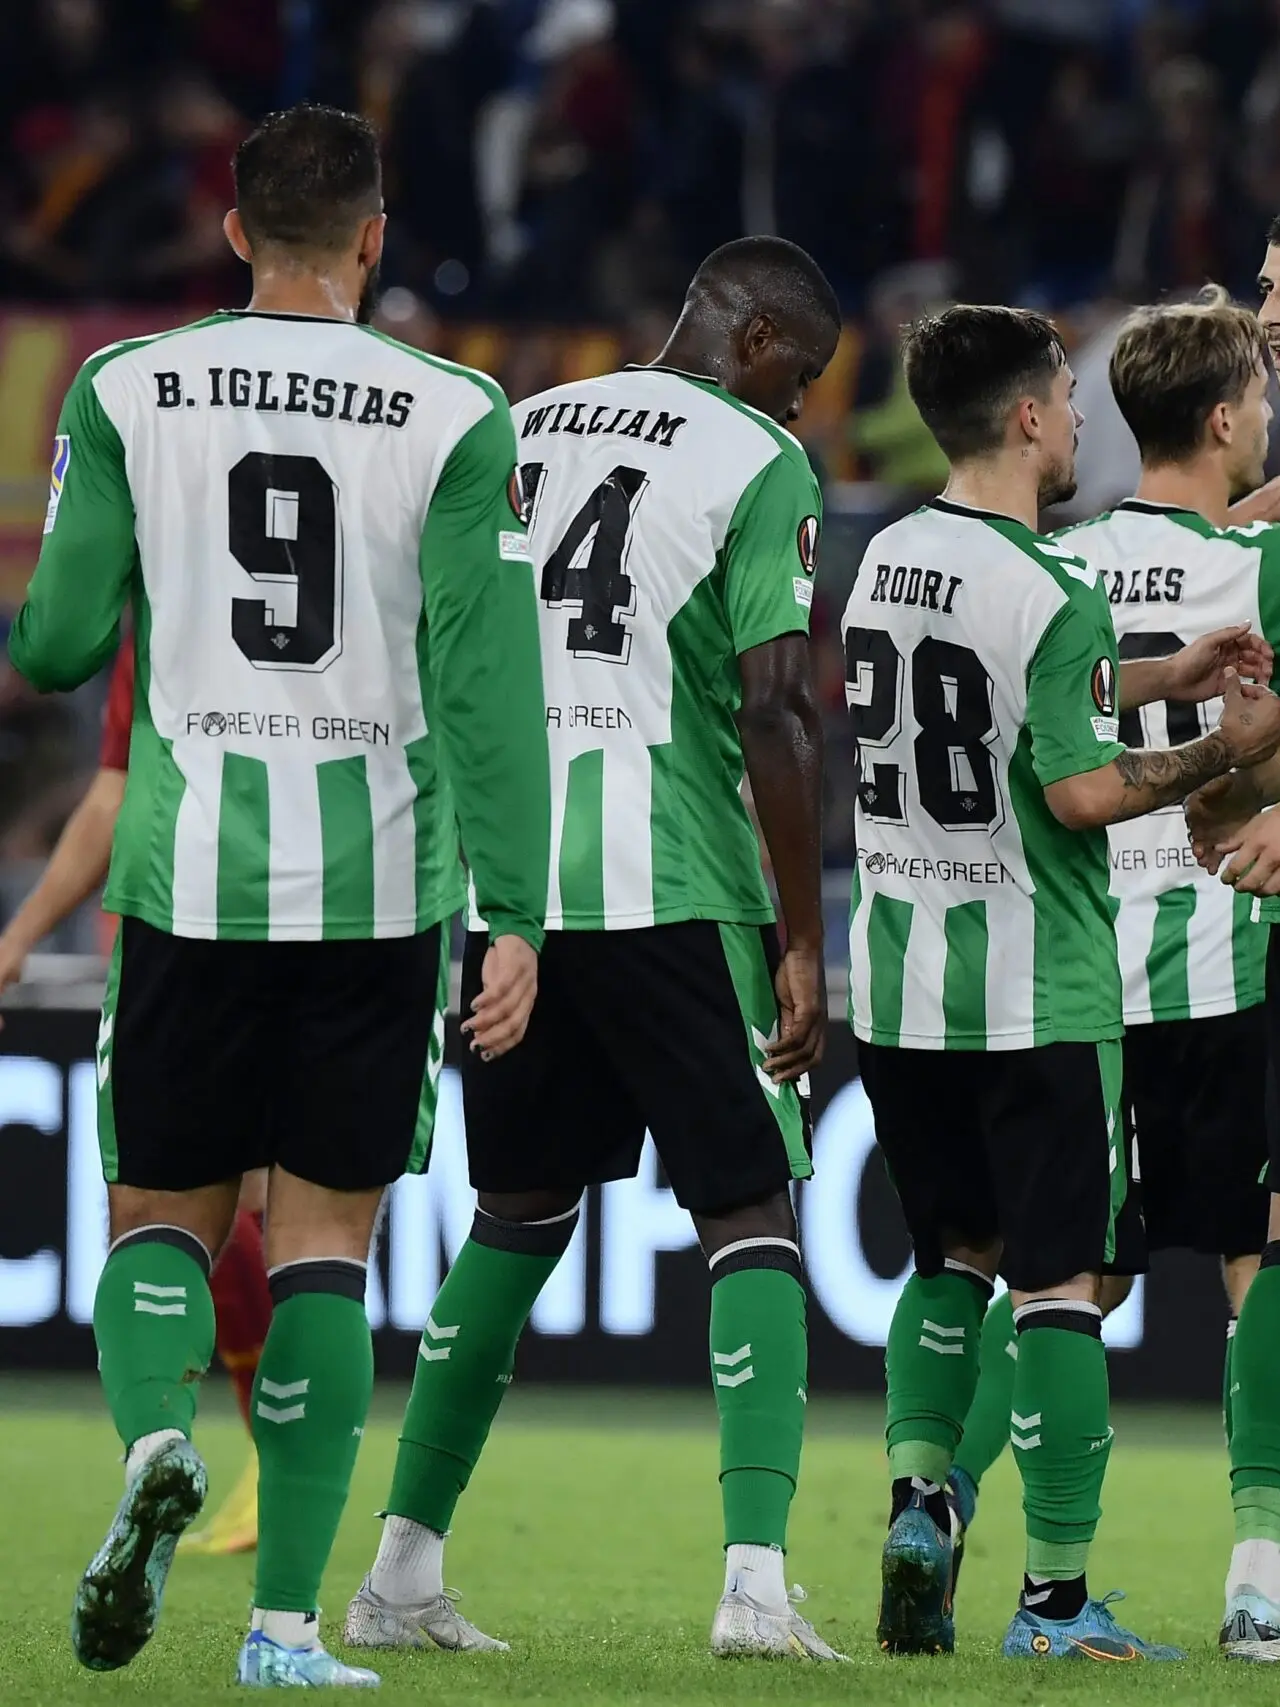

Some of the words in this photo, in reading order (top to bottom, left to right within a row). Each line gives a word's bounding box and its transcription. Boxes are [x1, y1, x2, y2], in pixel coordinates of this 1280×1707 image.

[154, 371, 197, 409] B.
[208, 367, 415, 429] IGLESIAS
[520, 403, 688, 448] WILLIAM
[228, 451, 343, 673] 9
[870, 564, 963, 614] RODRI
[312, 718, 390, 747] GREEN
[568, 705, 633, 729] GREEN
[845, 626, 1005, 833] 28
[1155, 847, 1195, 869] GRE
